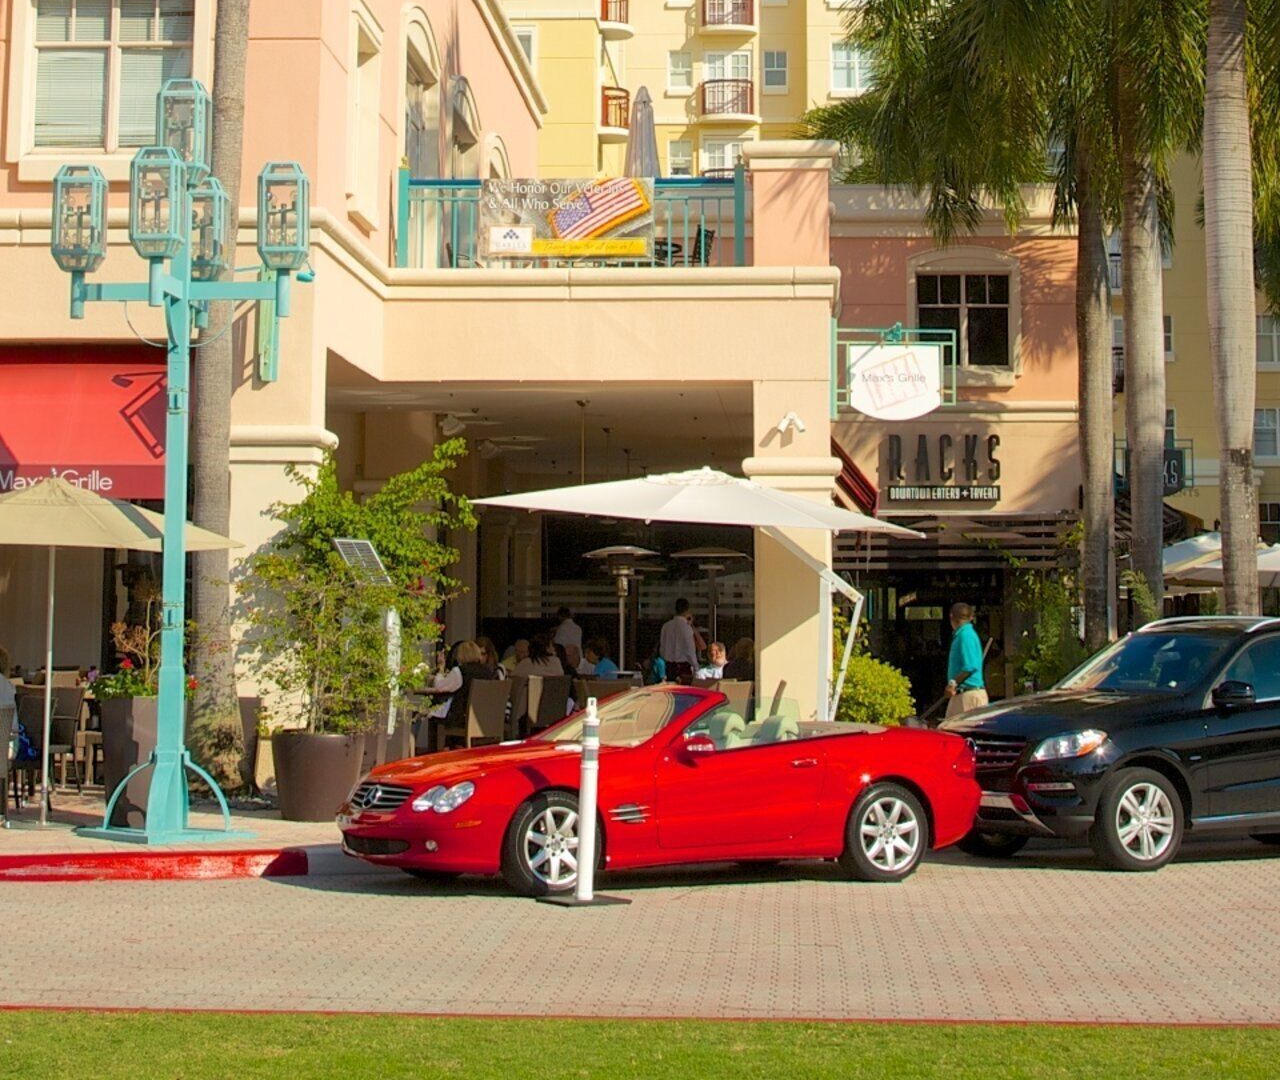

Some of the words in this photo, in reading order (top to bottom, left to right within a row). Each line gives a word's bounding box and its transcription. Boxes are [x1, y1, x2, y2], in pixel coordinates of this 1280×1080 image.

[488, 182, 510, 194] We
[511, 182, 546, 194] Honor
[550, 182, 571, 194] Our
[576, 182, 625, 194] Veterans
[488, 198, 498, 210] &
[501, 198, 519, 210] All
[521, 198, 549, 210] Who
[552, 198, 584, 210] Serve
[862, 373, 895, 383] Max's
[898, 372, 927, 383] Grille
[888, 434, 1001, 481] RACKS
[890, 487, 932, 500] DOWNTOWN
[932, 487, 961, 500] EATERY
[970, 487, 999, 500] TAVERN
